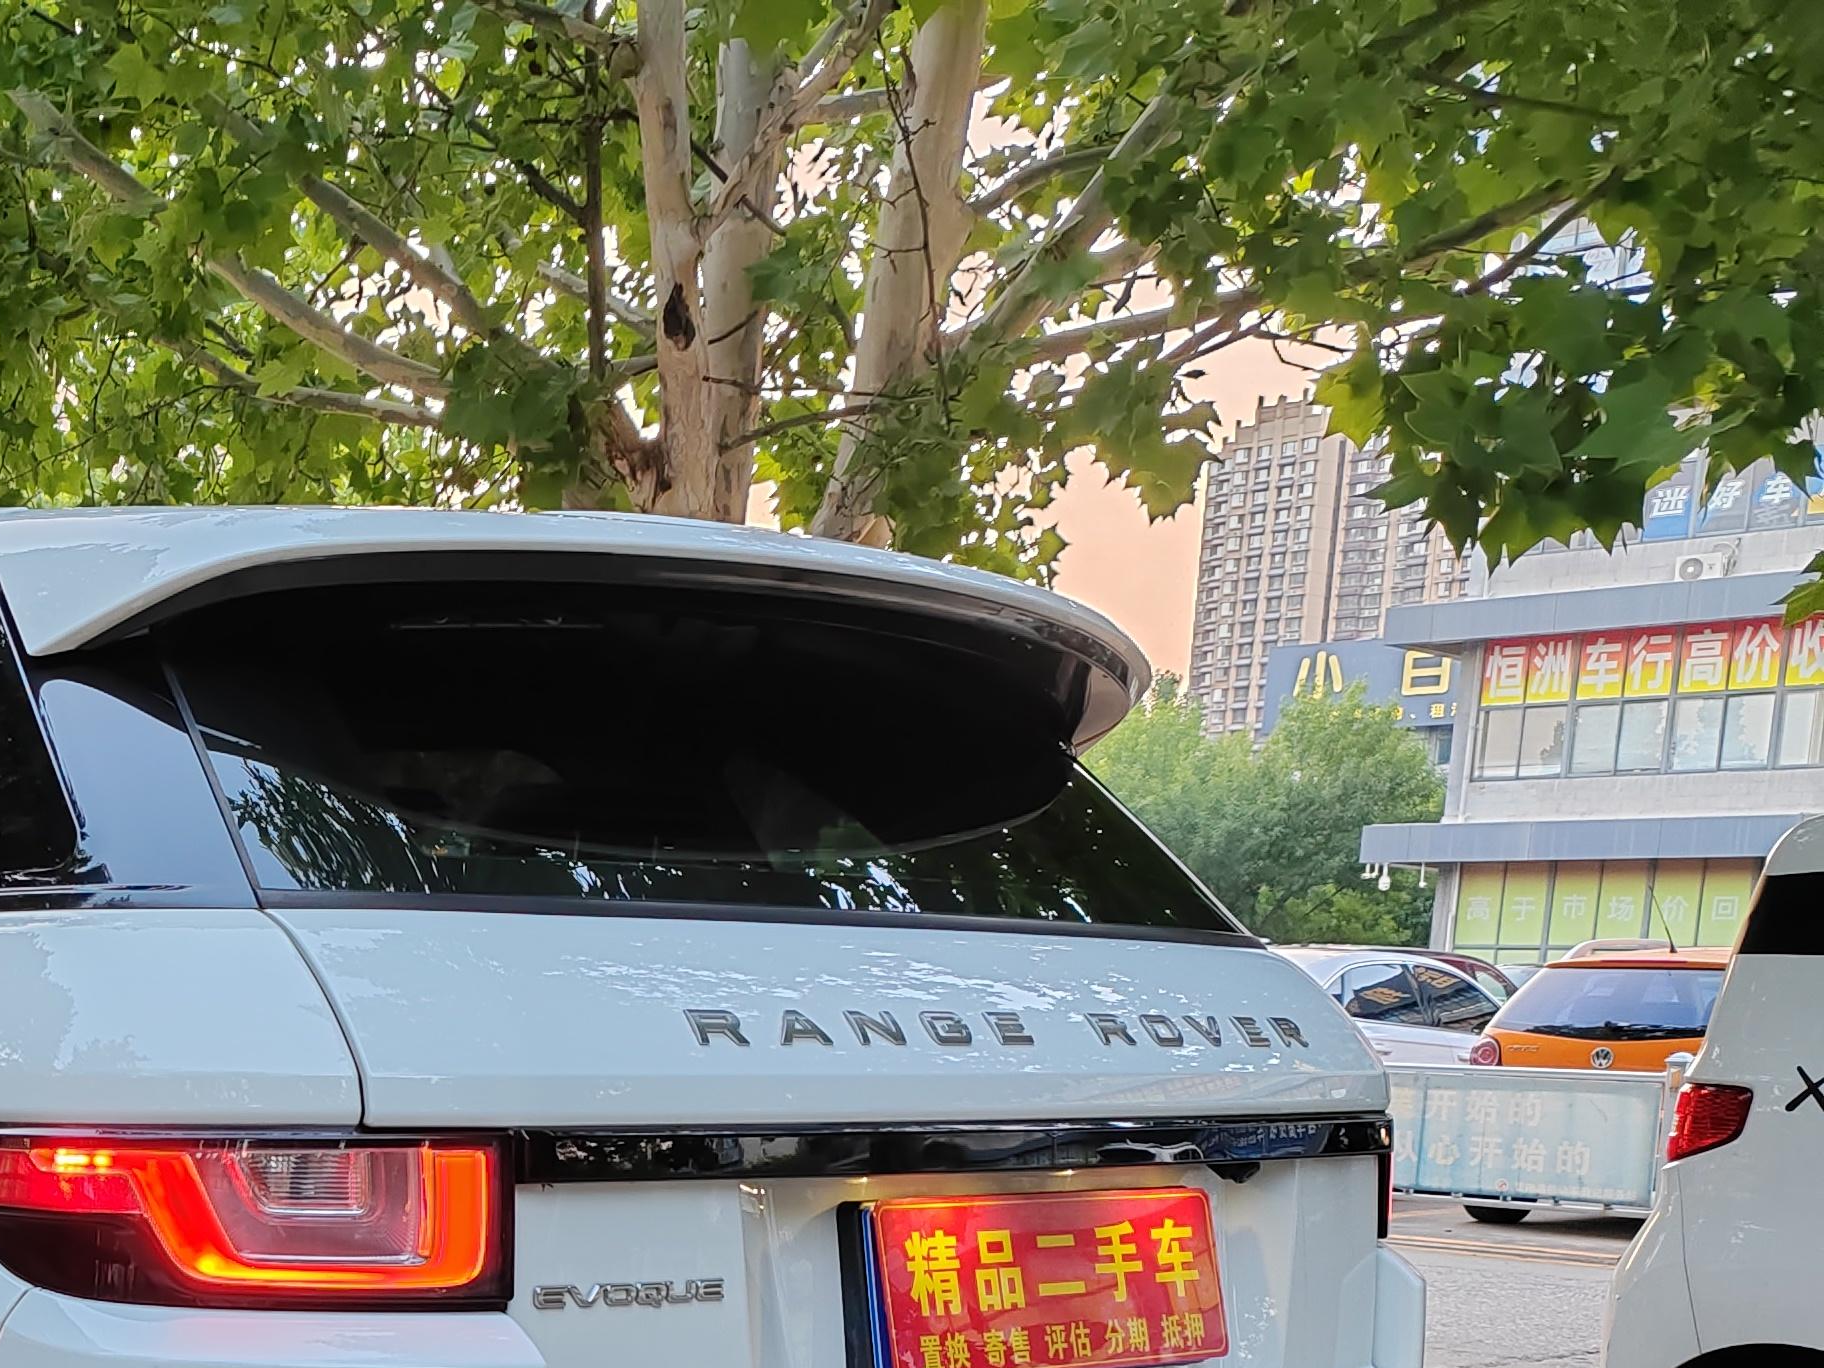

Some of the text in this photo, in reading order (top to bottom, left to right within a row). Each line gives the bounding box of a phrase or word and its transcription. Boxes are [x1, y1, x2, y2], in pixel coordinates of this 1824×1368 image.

[1465, 894, 1739, 922] 高于市场价回
[683, 1008, 1310, 1049] RANGE ROVER
[904, 1217, 1200, 1317] 精品二手车
[533, 1277, 725, 1310] EVOQUE
[983, 1327, 1032, 1367] 寄售
[1045, 1321, 1092, 1360] 评估
[1105, 1316, 1151, 1354] 分期
[1160, 1311, 1205, 1349] 抵押
